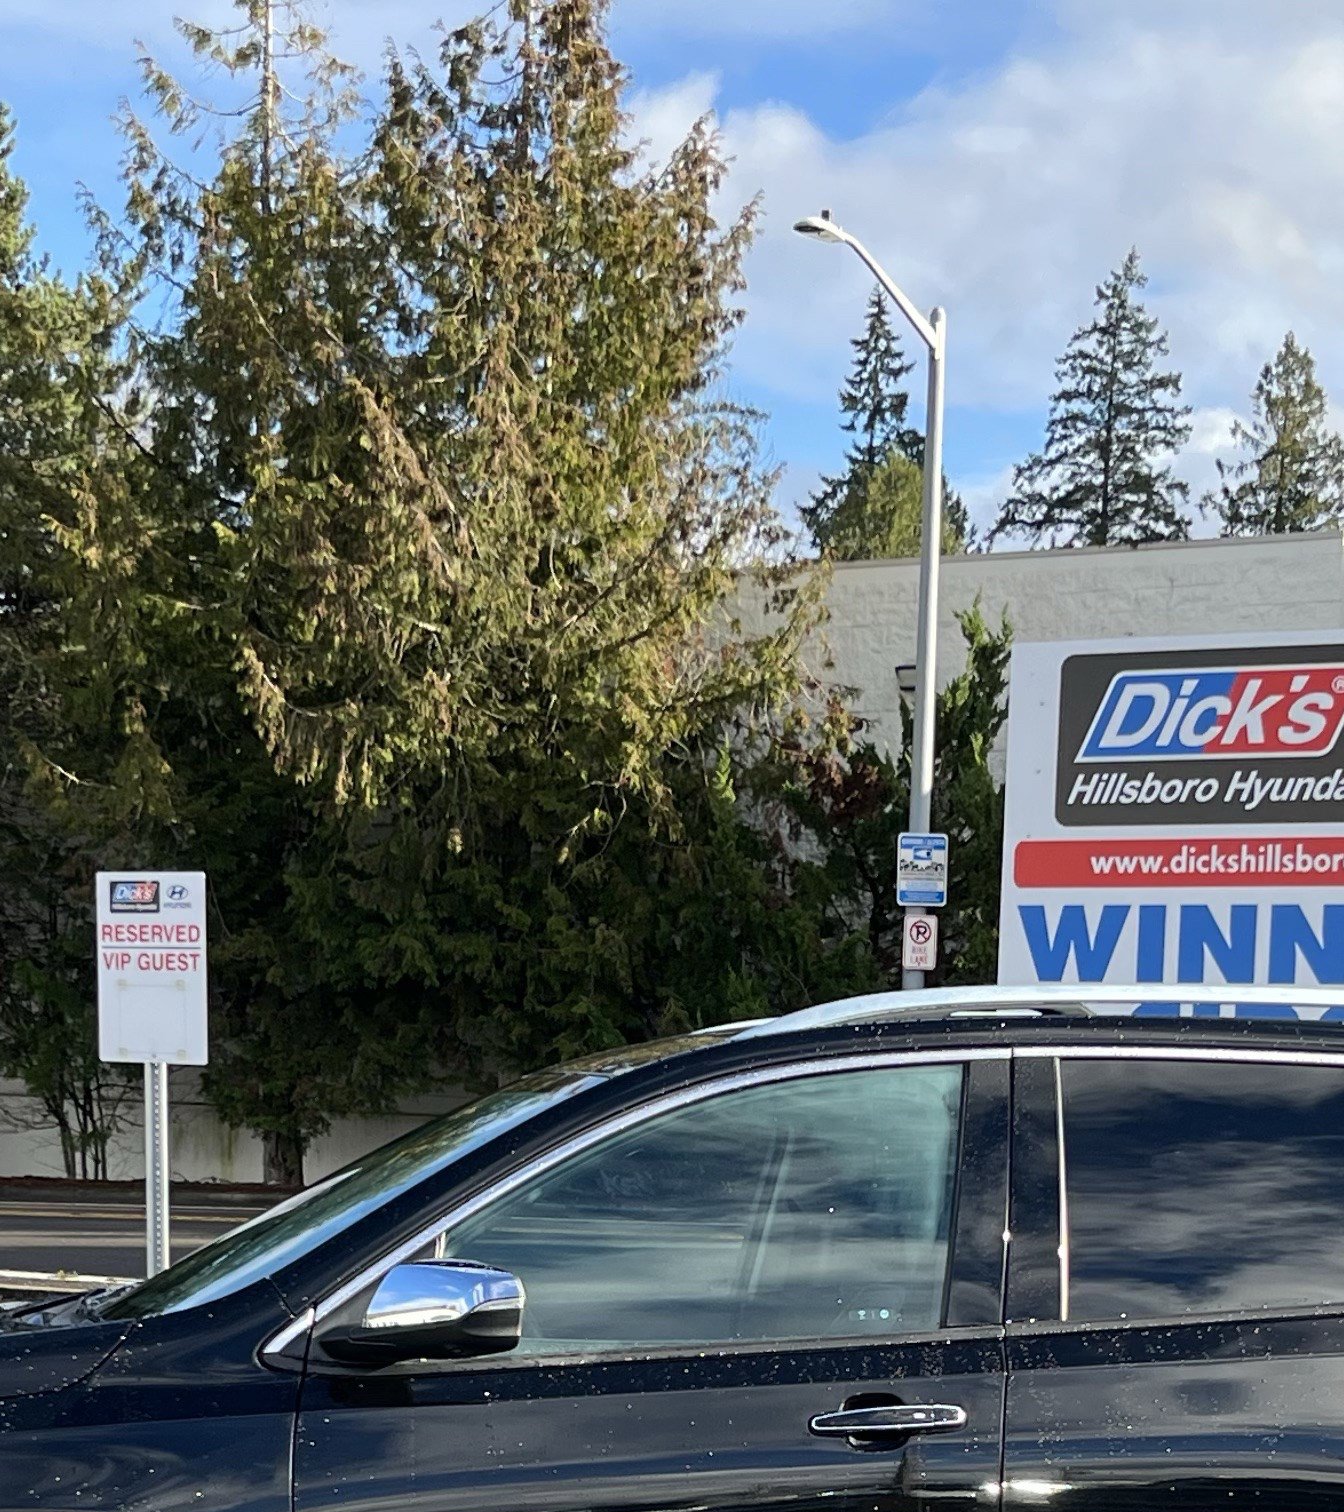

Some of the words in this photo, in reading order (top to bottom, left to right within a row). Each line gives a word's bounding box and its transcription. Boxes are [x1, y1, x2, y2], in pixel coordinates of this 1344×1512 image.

[1098, 675, 1334, 748] Dick's
[1067, 771, 1219, 806] Hillsboro
[101, 924, 200, 943] RESERVED
[103, 952, 131, 971] VIP
[137, 953, 200, 972] GUEST
